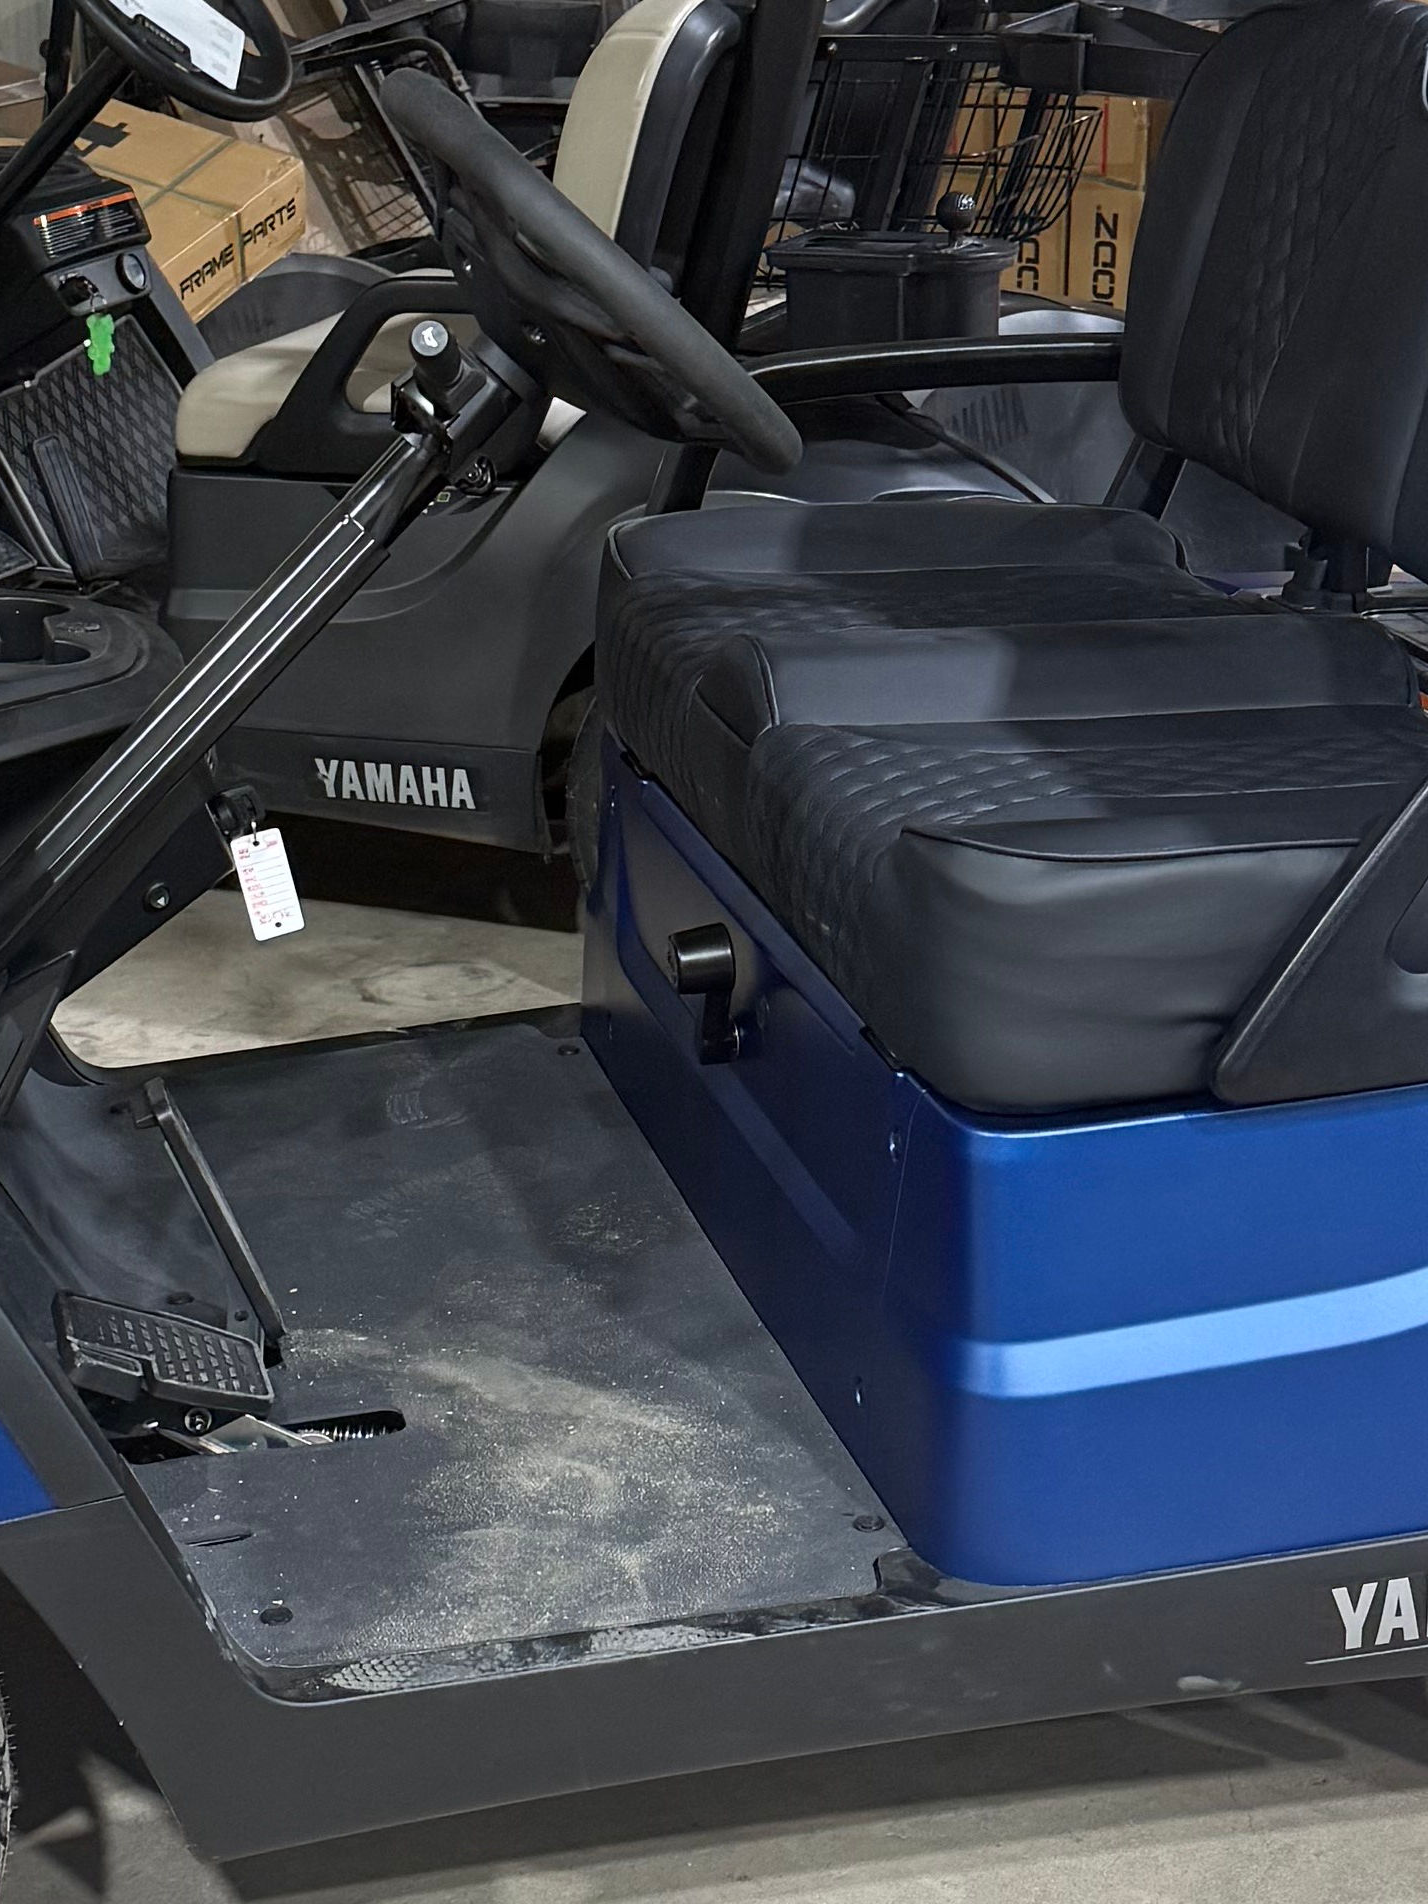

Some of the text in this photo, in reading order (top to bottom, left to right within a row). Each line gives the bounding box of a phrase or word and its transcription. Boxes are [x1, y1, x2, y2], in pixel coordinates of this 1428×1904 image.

[179, 197, 296, 300] FRAME PARTS
[314, 757, 476, 810] YAMAHA
